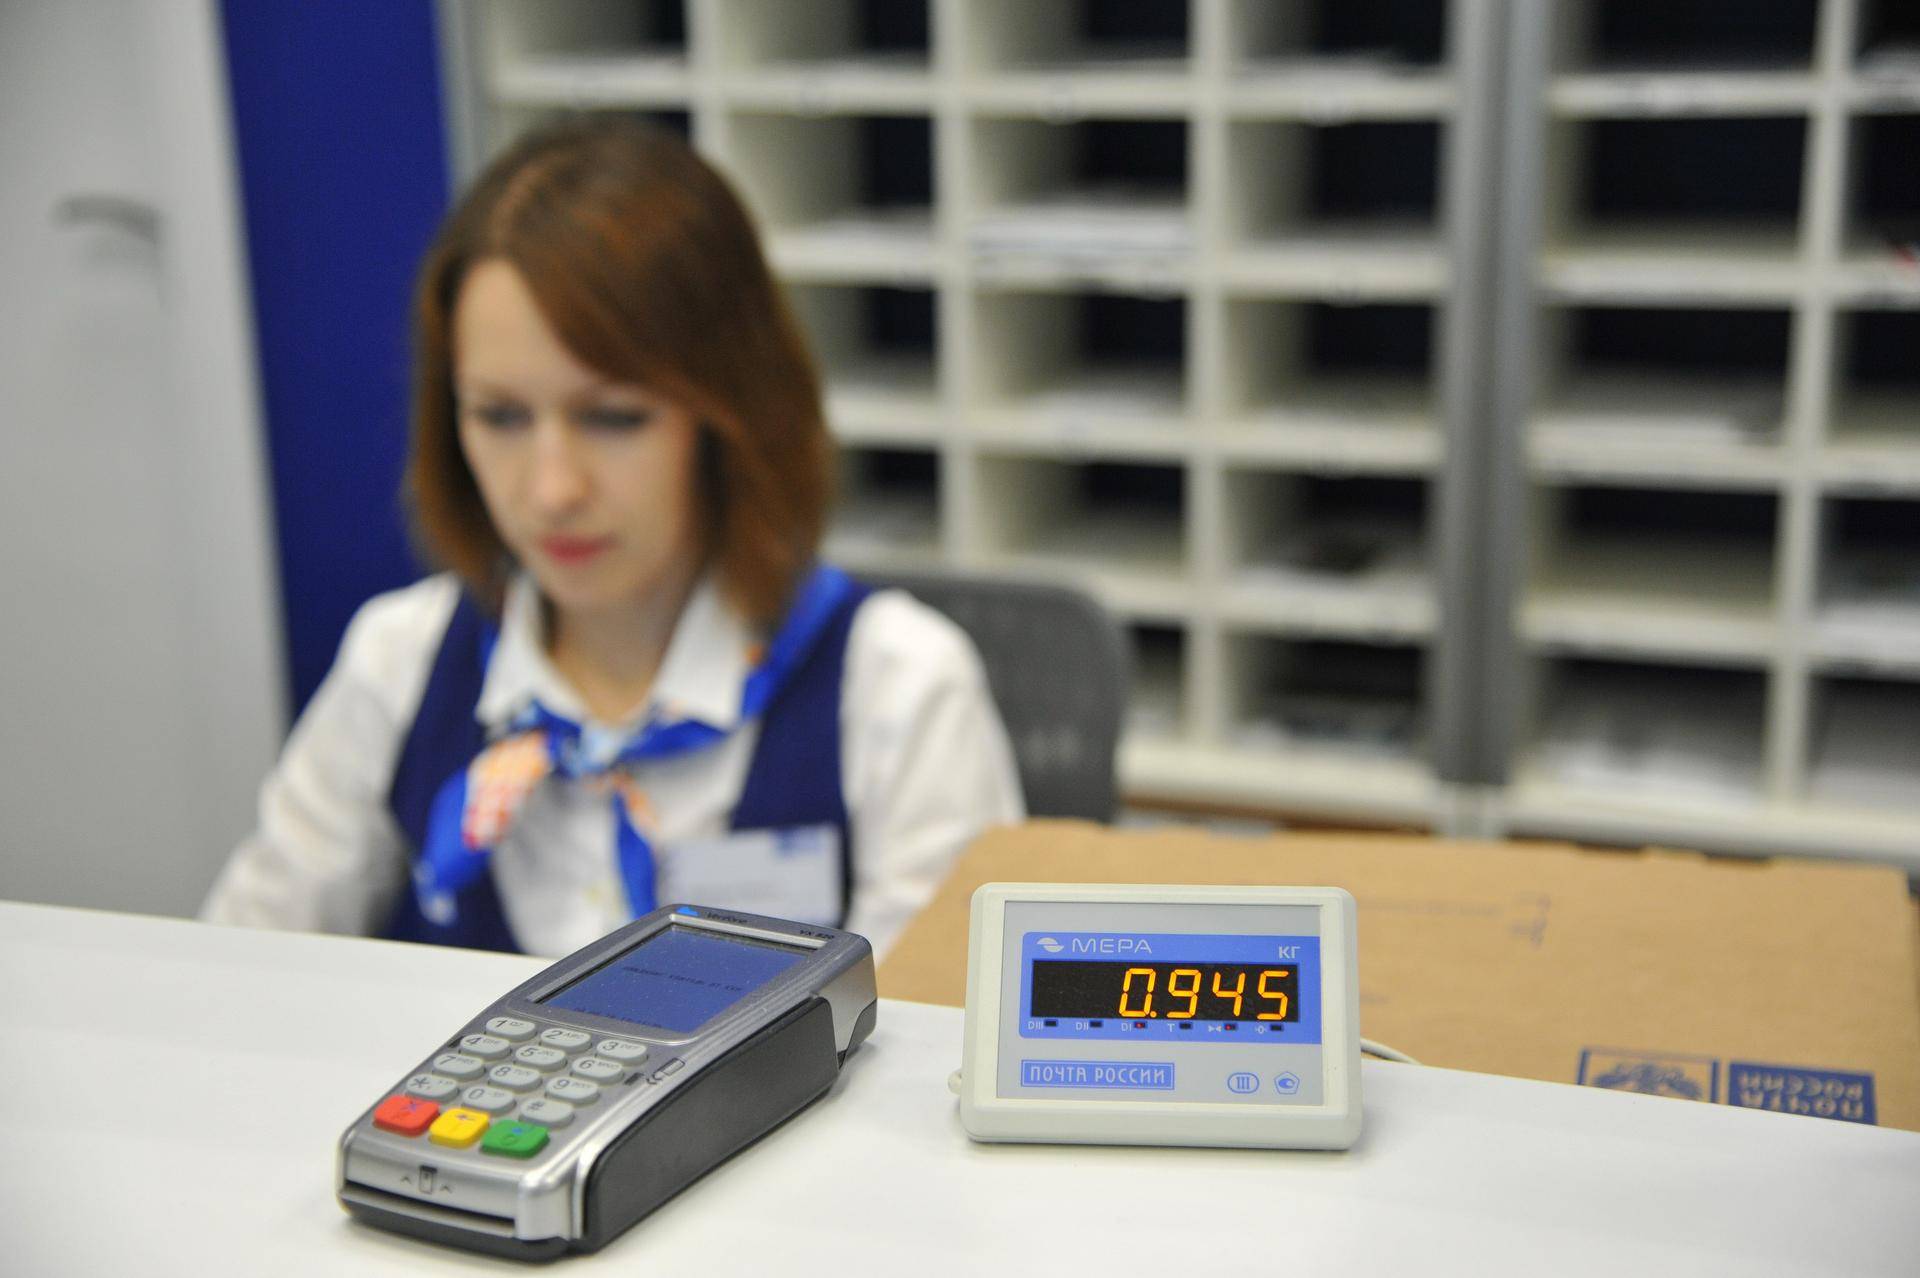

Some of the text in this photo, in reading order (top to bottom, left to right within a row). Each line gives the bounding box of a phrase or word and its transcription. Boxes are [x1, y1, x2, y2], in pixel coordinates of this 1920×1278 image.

[1072, 938, 1153, 953] МЕРА
[1118, 967, 1290, 1020] 0.945
[495, 1019, 508, 1028] 1
[545, 1029, 563, 1039] 2
[466, 1036, 482, 1045] 4
[602, 1041, 618, 1051] 3
[521, 1047, 539, 1057] 5
[439, 1055, 457, 1065] 7
[579, 1059, 595, 1069] 6
[495, 1066, 511, 1077] 8
[1030, 1066, 1165, 1084] ПОЧТА РОССИИ
[553, 1079, 570, 1090] 9
[468, 1088, 485, 1100] 0
